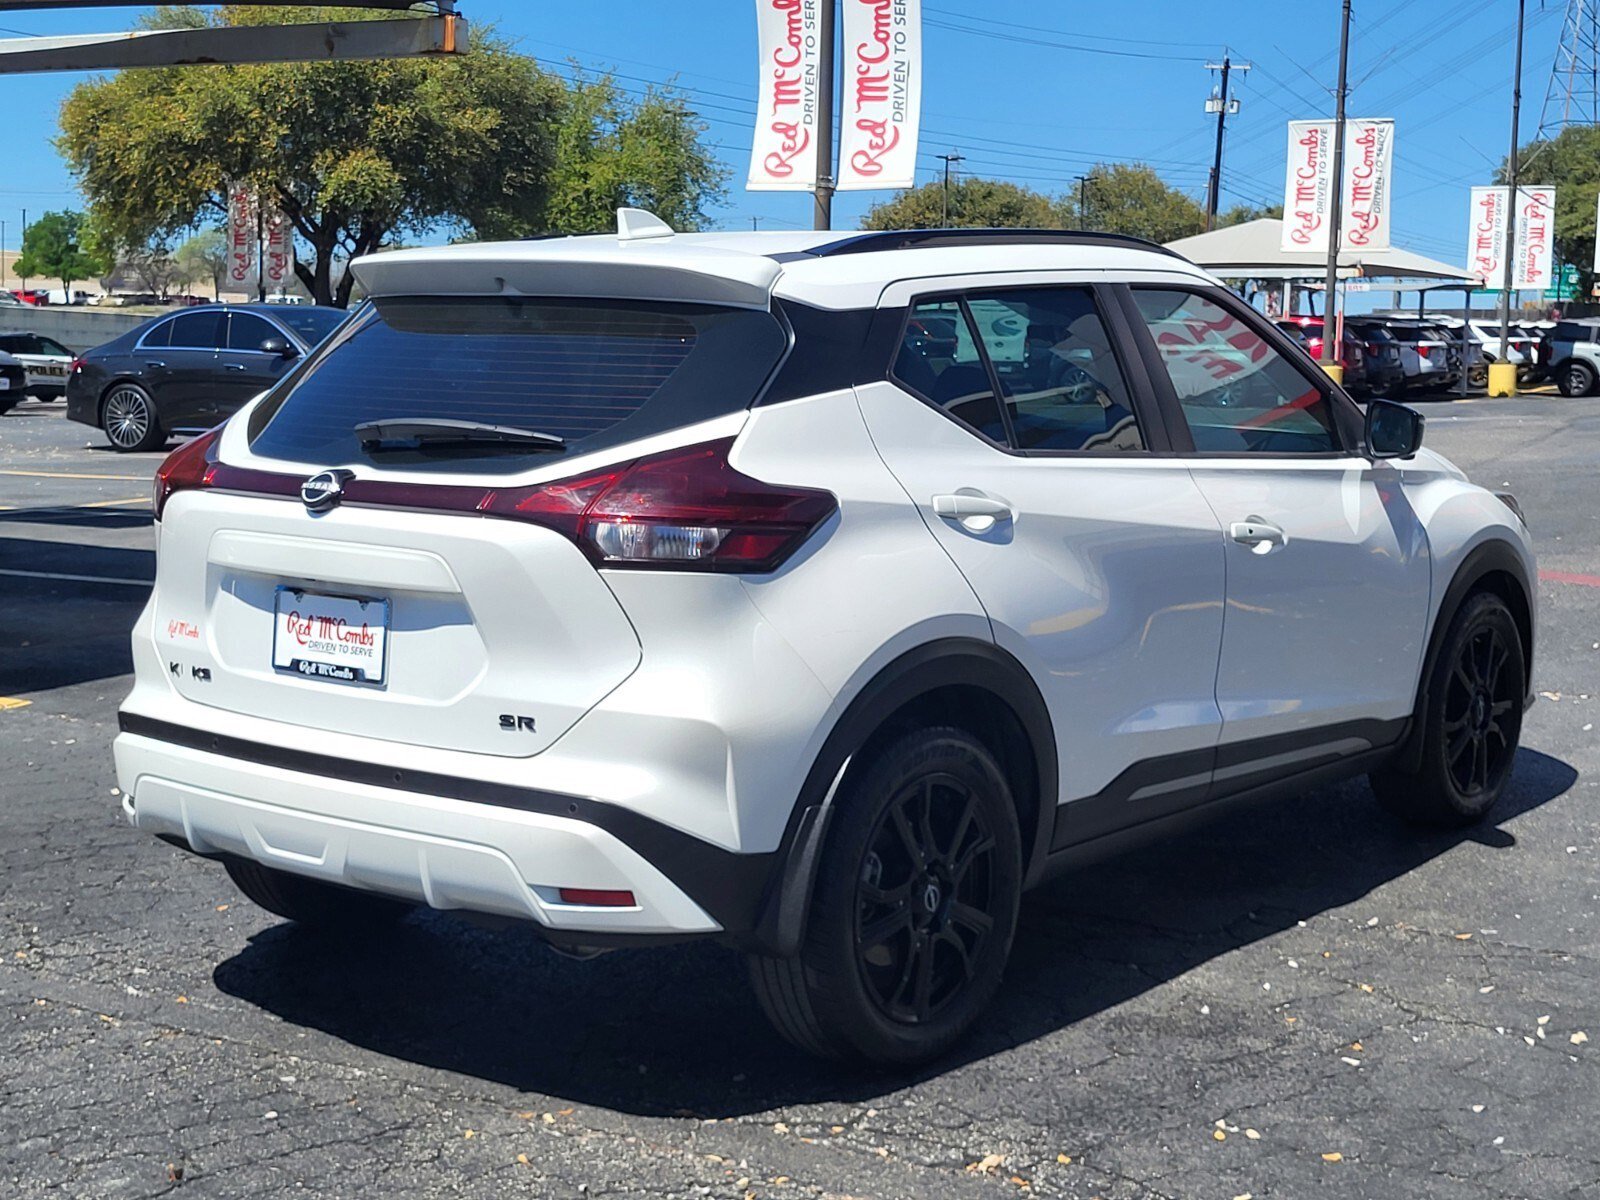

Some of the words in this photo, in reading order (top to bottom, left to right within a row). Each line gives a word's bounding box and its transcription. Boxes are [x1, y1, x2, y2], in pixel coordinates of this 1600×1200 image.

[804, 35, 816, 58] TO
[894, 31, 906, 54] TO
[803, 63, 816, 125] DRIVEN
[892, 60, 906, 122] DRIVEN
[764, 122, 809, 178] Red
[851, 118, 899, 176] Red
[1319, 128, 1328, 158] SERVE
[1377, 127, 1385, 158] SERVE
[1295, 128, 1319, 208] McCombs
[1319, 161, 1327, 174] TO
[1352, 127, 1376, 206] McCombs
[1376, 160, 1383, 174] TO
[1317, 177, 1326, 214] DRIVEN
[1374, 177, 1382, 214] DRIVEN
[1291, 211, 1321, 244] Red
[1348, 211, 1379, 246] Red
[1495, 218, 1502, 228] TO
[1493, 228, 1502, 259] DRIVEN
[232, 253, 251, 280] Red
[268, 252, 288, 280] Red
[287, 611, 313, 645] Red
[316, 615, 374, 646] McCombs
[308, 640, 336, 652] DRIVEN
[339, 644, 349, 653] TO
[351, 646, 373, 657] SERVE
[299, 661, 316, 674] Red
[317, 664, 353, 679] McCombs
[499, 715, 537, 733] SR
